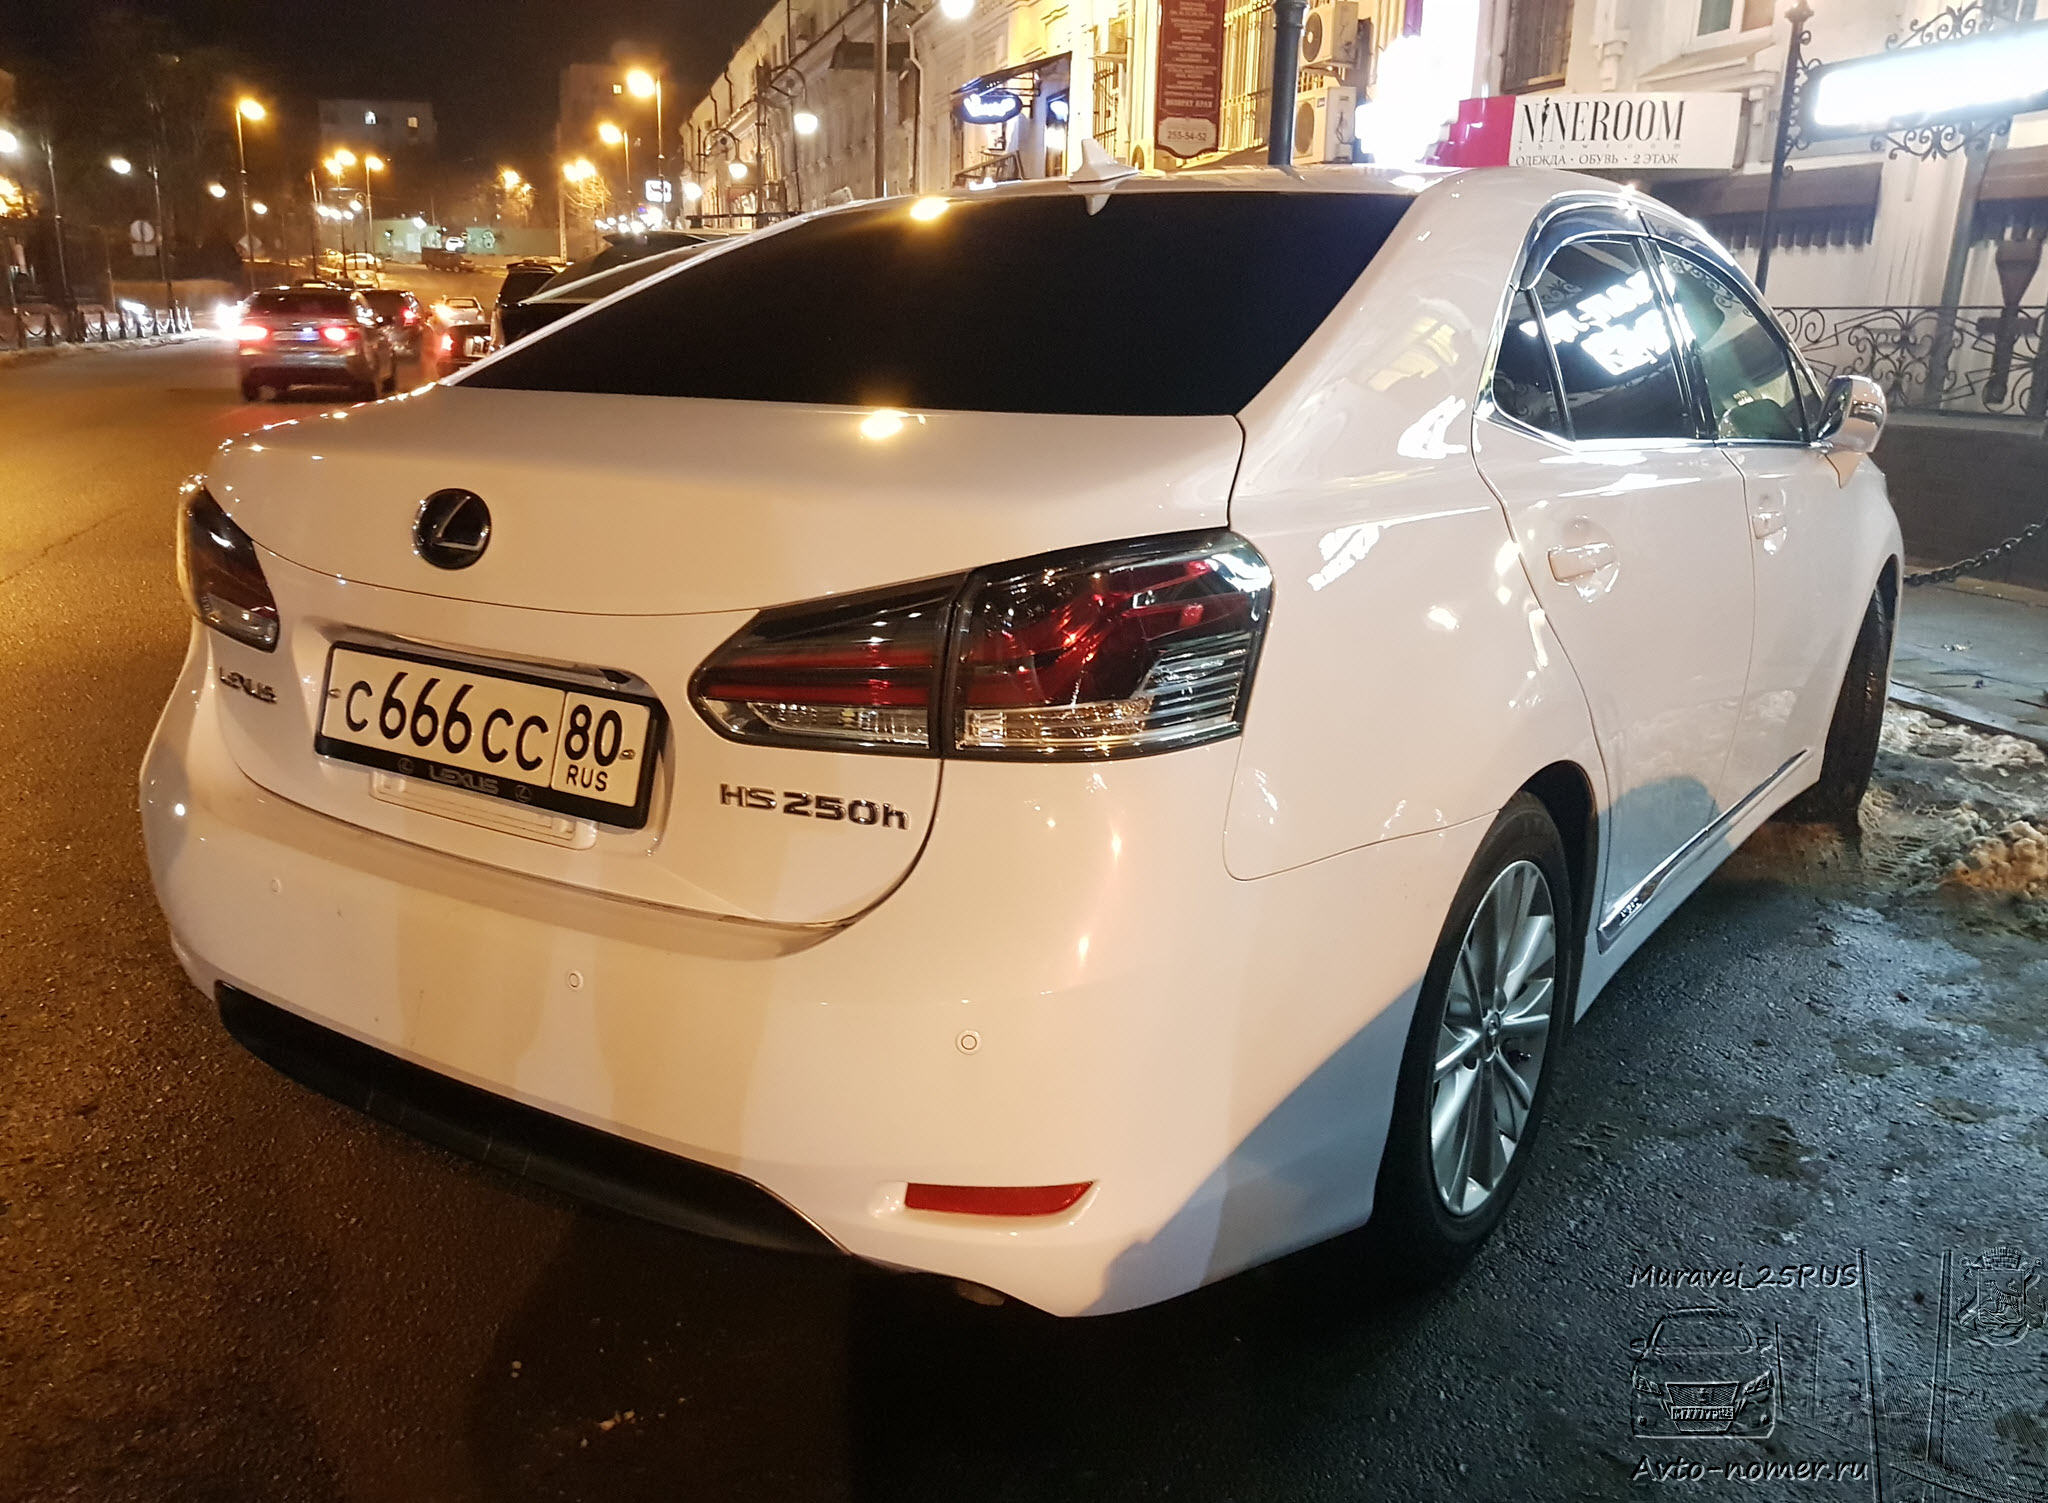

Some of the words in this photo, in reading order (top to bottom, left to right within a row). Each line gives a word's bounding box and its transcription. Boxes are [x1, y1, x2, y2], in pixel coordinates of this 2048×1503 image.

[1519, 98, 1687, 143] NINEROOM
[1167, 130, 1206, 141] 255-54-52
[1515, 154, 1567, 167] ОДЕЖДА
[1578, 153, 1619, 165] ОБУВЬ
[1633, 154, 1641, 165] 2
[1642, 153, 1679, 165] ЭТАЖ
[564, 704, 623, 767] 80
[428, 764, 500, 795] LEXUS
[566, 764, 609, 792] RUS
